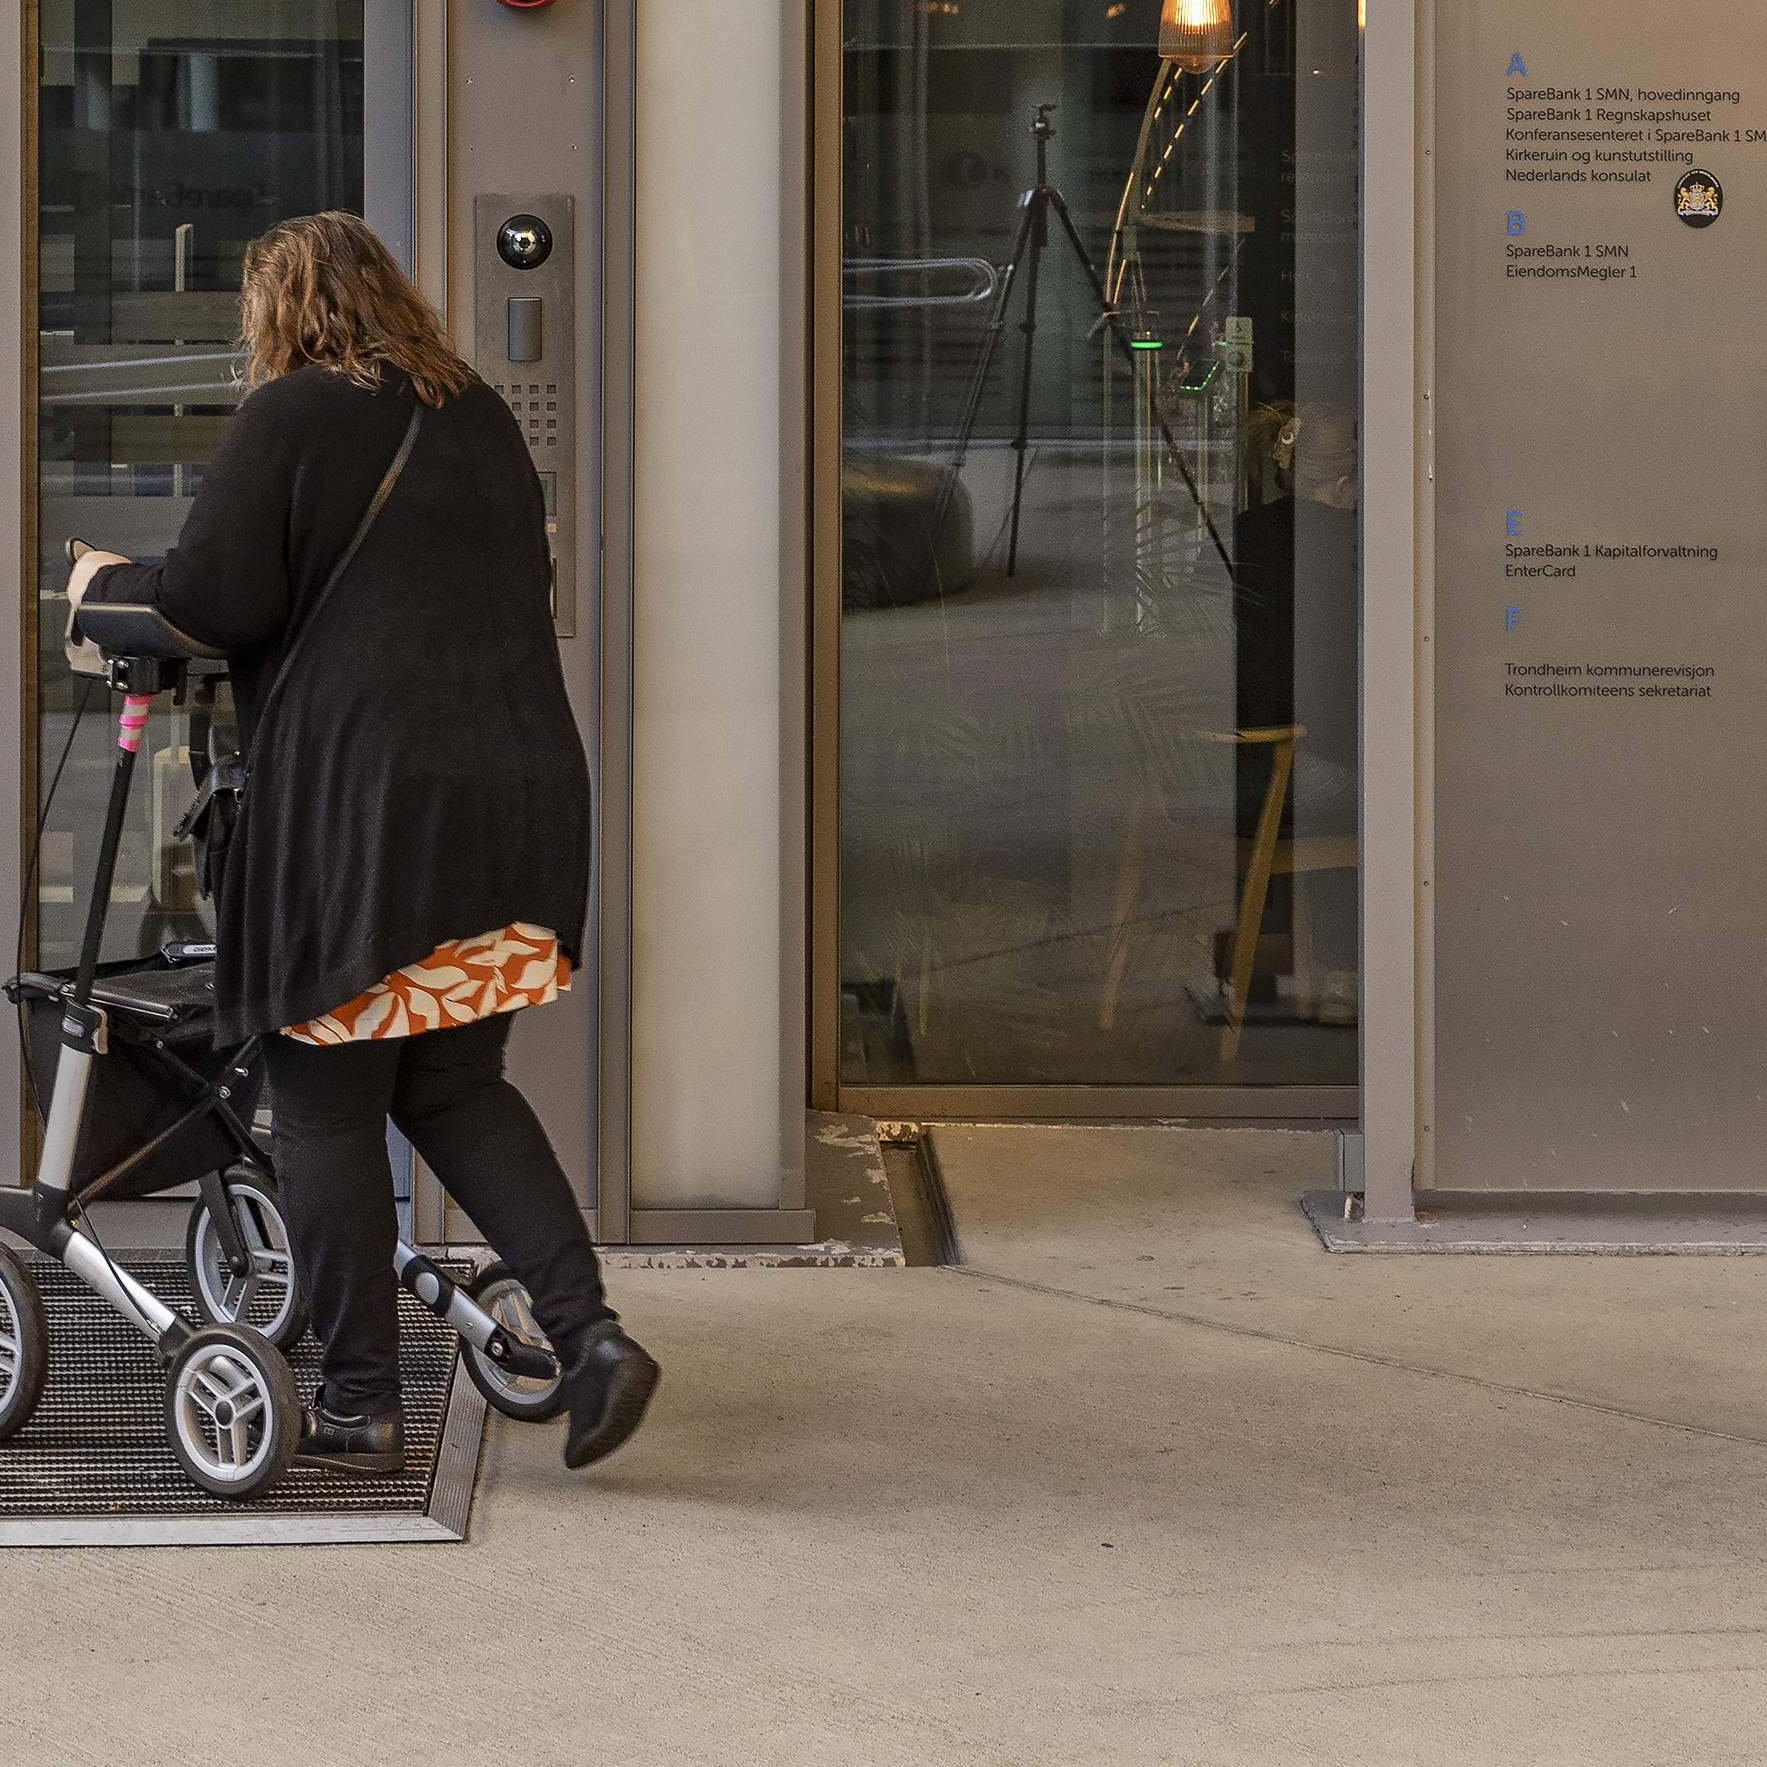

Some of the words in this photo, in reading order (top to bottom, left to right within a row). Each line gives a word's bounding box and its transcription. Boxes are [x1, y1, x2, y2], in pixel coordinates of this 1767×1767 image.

[1507, 52, 1527, 76] A
[1506, 86, 1581, 103] SpareBank
[1585, 87, 1592, 101] 1
[1596, 87, 1633, 102] SMN,
[1637, 88, 1741, 105] hovedinngang
[1506, 107, 1581, 123] SpareBank
[1585, 108, 1592, 121] 1
[1596, 107, 1711, 125] Regnskapshuset
[1505, 128, 1644, 142] Konferansesenteret
[1647, 128, 1652, 142] i
[1655, 128, 1730, 144] SpareBank
[1734, 129, 1741, 143] 1
[1505, 148, 1568, 162] Kirkeruin
[1571, 151, 1591, 165] og
[1595, 149, 1694, 166] kunstutstilling
[1505, 168, 1587, 182] Nederlands
[1591, 169, 1651, 183] konsulat
[1508, 210, 1525, 235] B
[1506, 243, 1581, 260] SpareBank
[1584, 244, 1591, 258] 1
[1595, 244, 1629, 258] SMN
[1506, 264, 1626, 282] EiendomsMegler
[1630, 265, 1637, 279] 1
[1507, 510, 1522, 535] E
[1505, 543, 1580, 559] SpareBank
[1583, 544, 1591, 558] 1
[1595, 544, 1718, 562] Kapitalforvaltning
[1505, 564, 1576, 578] EnterCard
[1507, 607, 1521, 631] F
[1504, 662, 1583, 677] Trondheim
[1585, 663, 1715, 680] kommunerevisjon
[1505, 683, 1635, 697] Kontrollkomiteens
[1638, 684, 1712, 698] sekretariat
